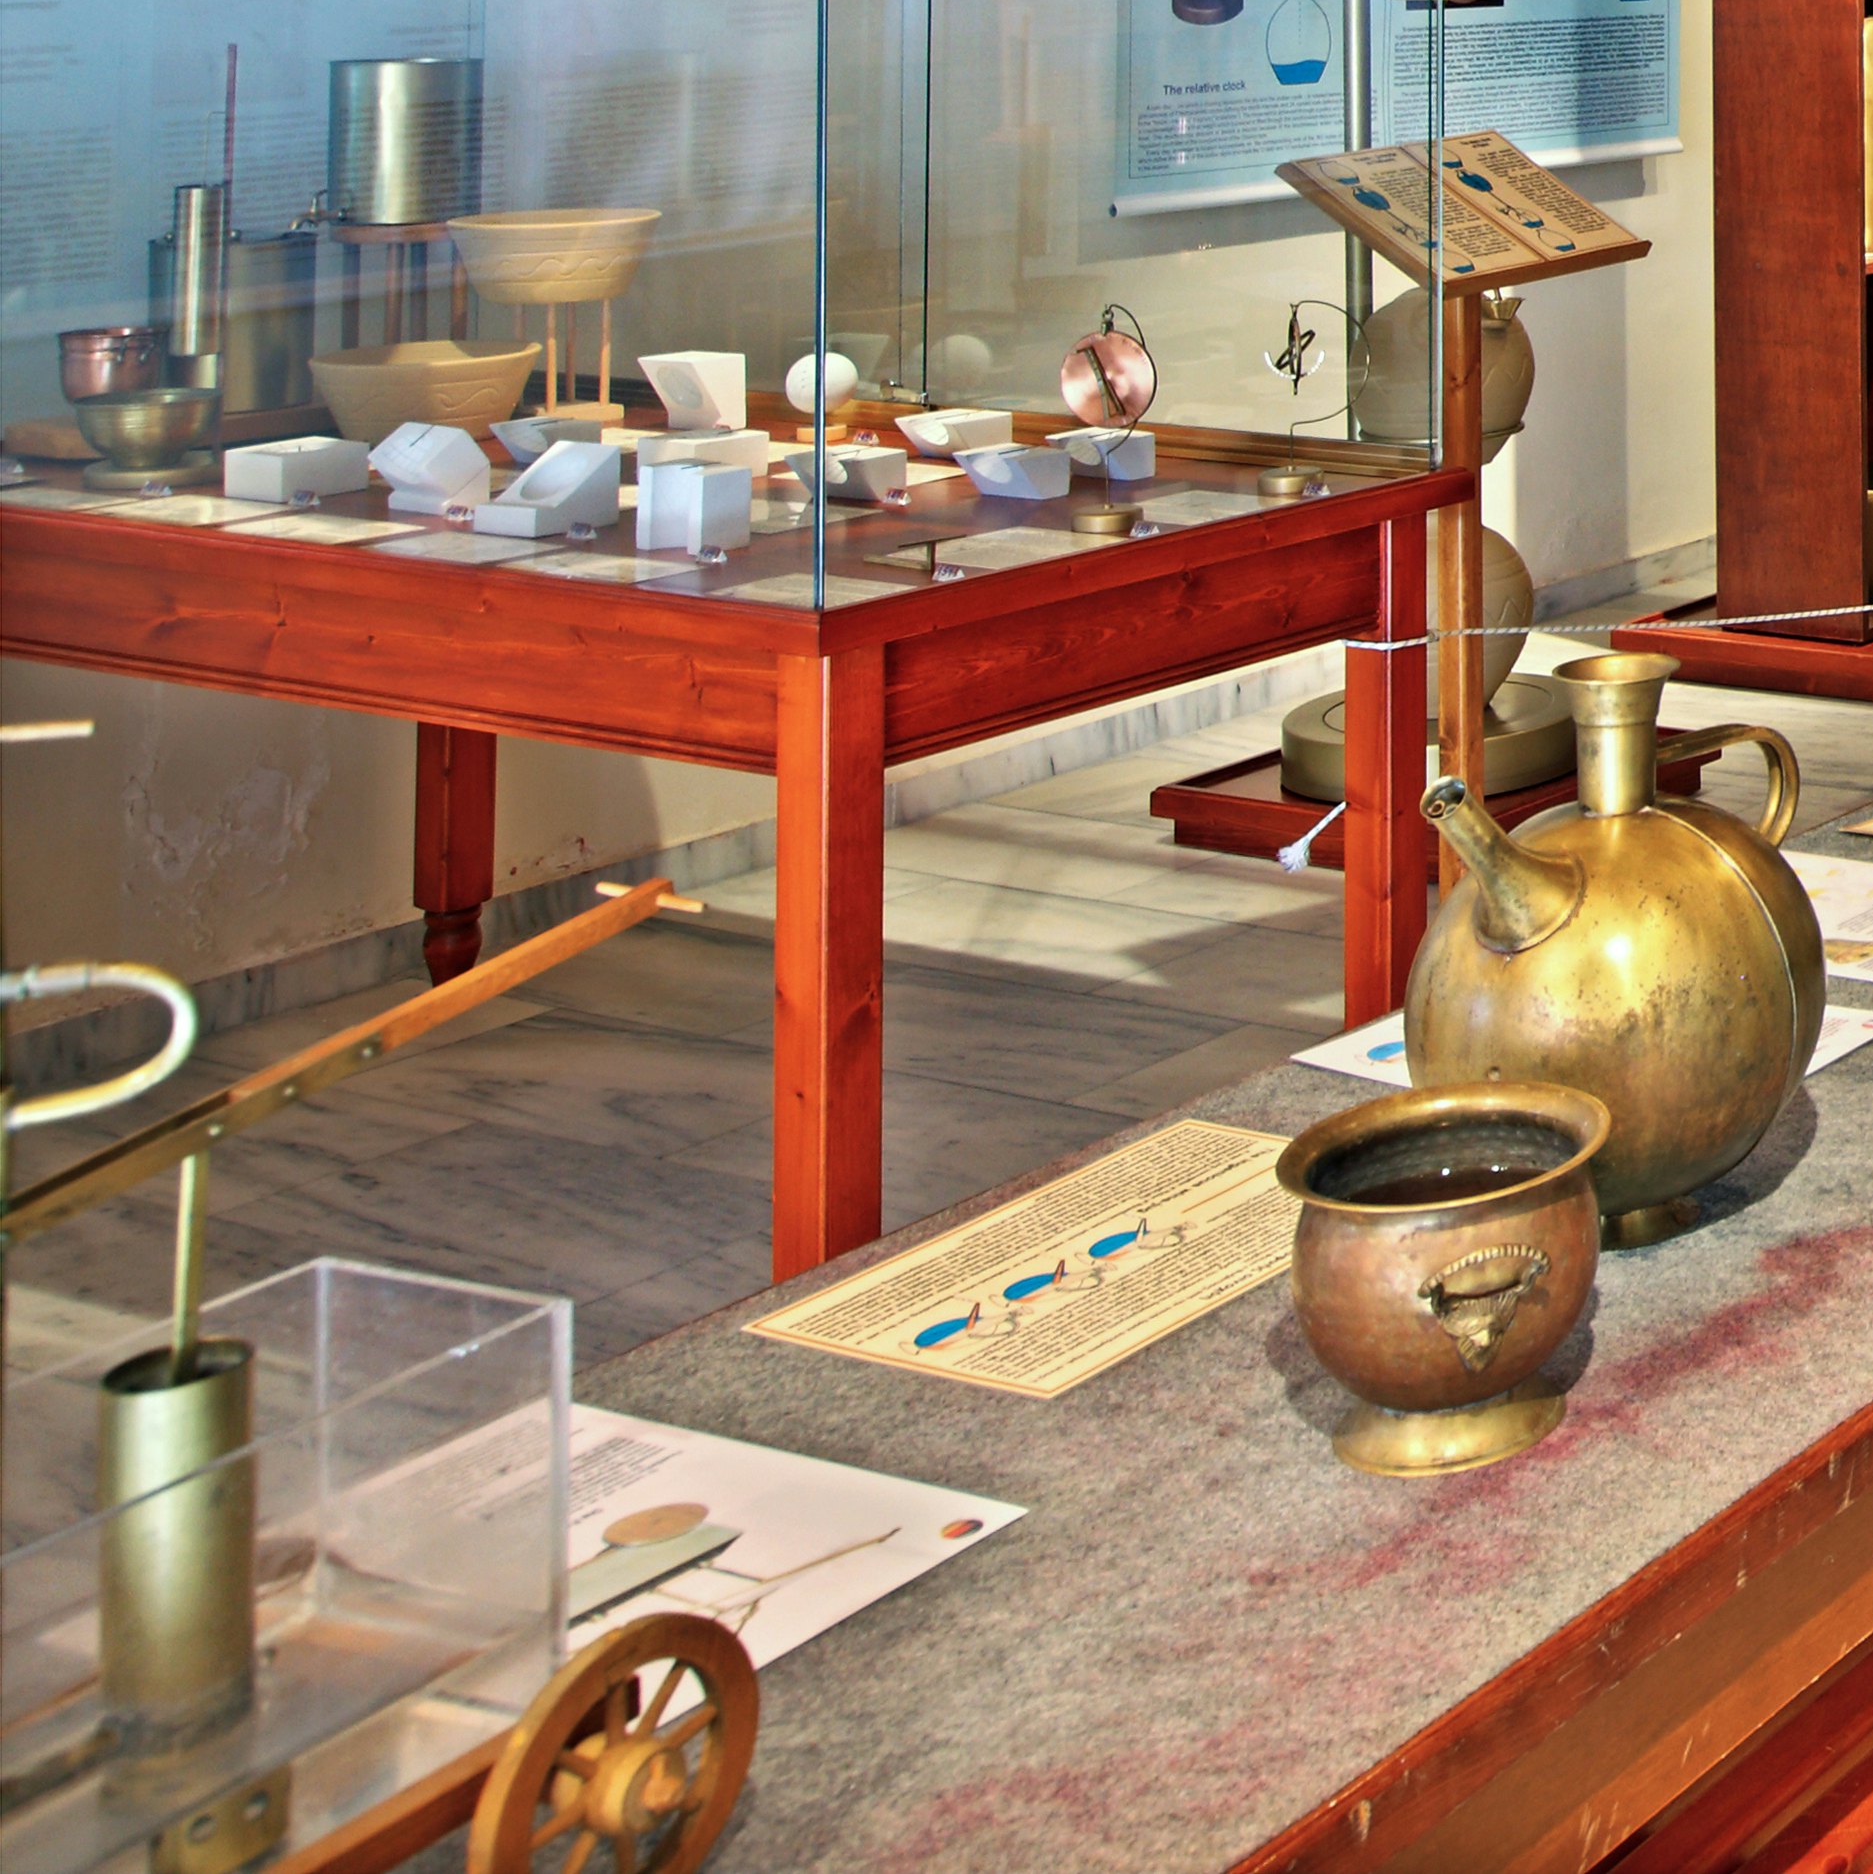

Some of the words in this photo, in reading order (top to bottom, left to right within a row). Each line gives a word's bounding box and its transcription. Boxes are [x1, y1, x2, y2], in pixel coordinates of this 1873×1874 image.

[1163, 84, 1183, 96] The
[1185, 83, 1220, 95] relative
[1222, 80, 1247, 92] clock
